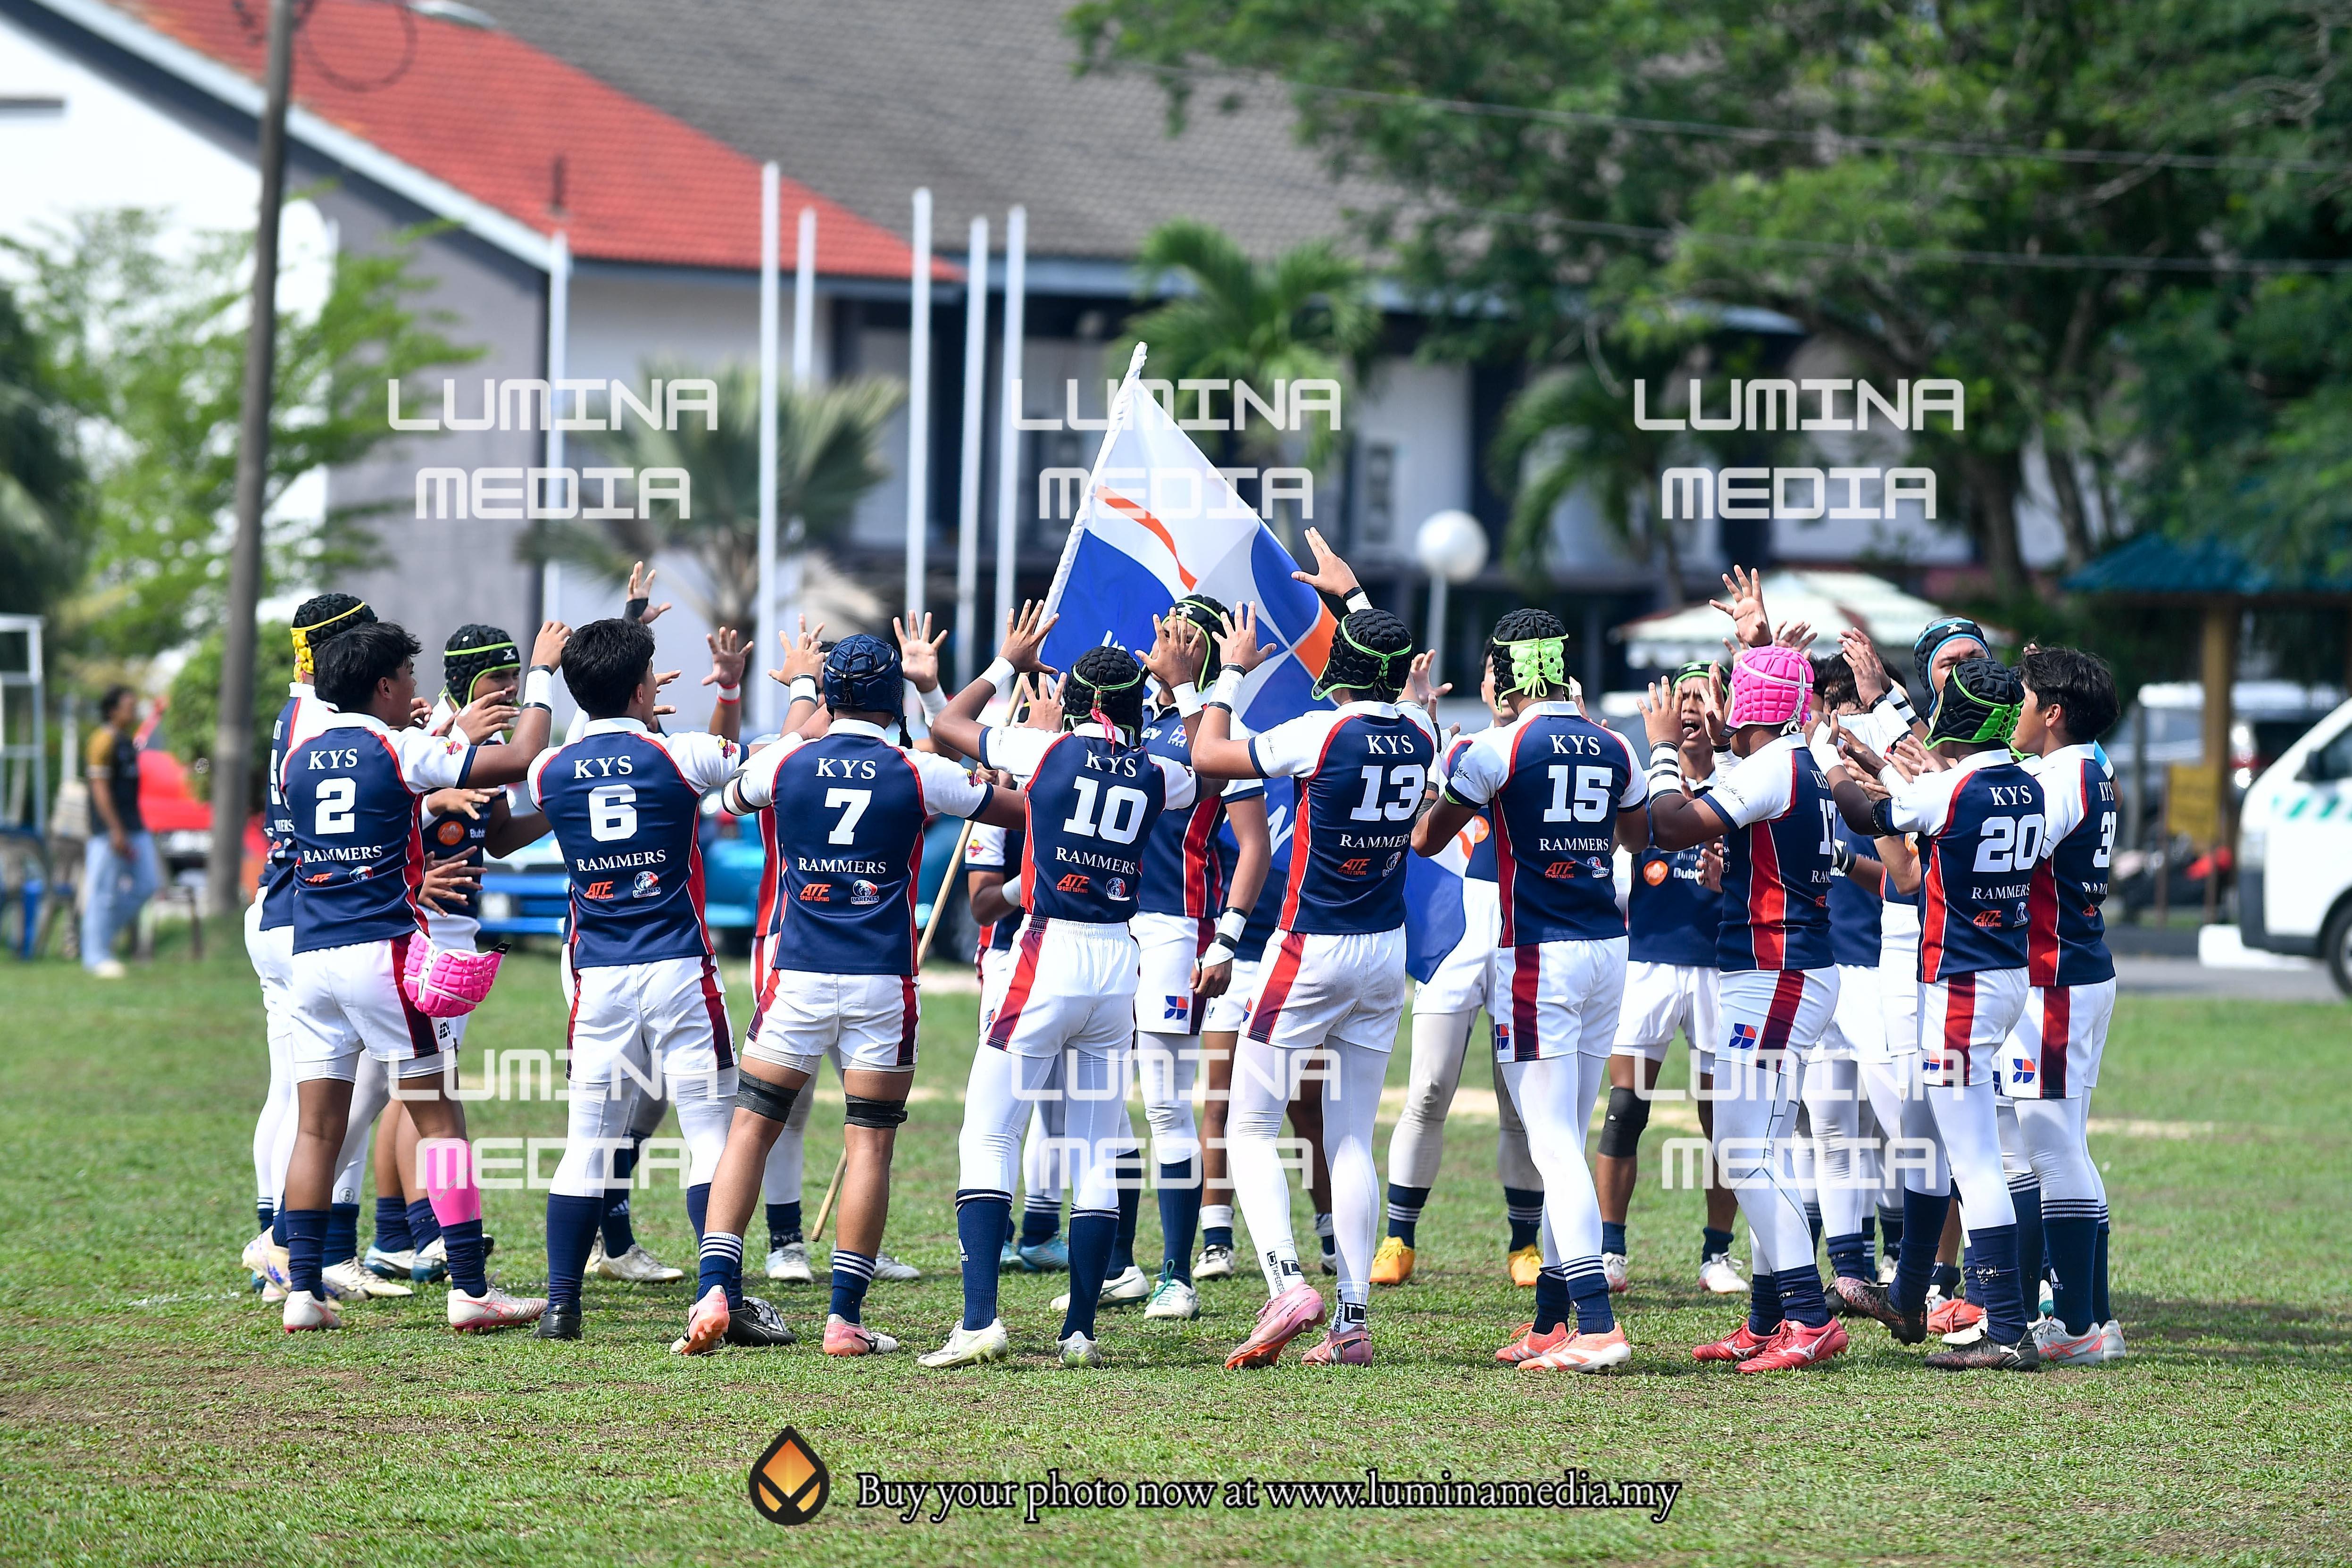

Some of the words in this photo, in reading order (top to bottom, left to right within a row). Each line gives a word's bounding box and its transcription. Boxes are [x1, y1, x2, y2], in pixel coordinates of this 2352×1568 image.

[1365, 735, 1414, 754] KYS
[1549, 734, 1601, 756] KYS
[308, 748, 358, 769] KYS
[574, 755, 633, 779] KYS
[816, 758, 876, 779] KYS
[1084, 750, 1137, 777] KYS
[1350, 764, 1425, 821] 13
[1543, 765, 1612, 822] 15
[1989, 786, 2032, 806] KYS
[2099, 781, 2114, 801] KYS
[315, 777, 357, 834] 2
[588, 784, 637, 842] 6
[1063, 776, 1148, 844] 10
[824, 788, 871, 845] 7
[1340, 834, 1409, 848] RAMMERS
[1539, 838, 1609, 851] RAMMERS
[1973, 814, 2045, 872] 20
[303, 846, 383, 863] RAMMERS
[576, 850, 666, 872] RAMMERS
[1056, 847, 1135, 875] RAMMERS
[1340, 859, 1371, 870] ATF
[798, 857, 886, 874] RAMMERS
[1545, 861, 1576, 874] ATF
[585, 881, 614, 895] ATF
[801, 884, 832, 896] ATF
[1057, 874, 1090, 888] ATF
[1971, 883, 2030, 899] RAMMERS
[634, 887, 661, 896] PARENTS
[1973, 910, 2001, 922] ATF
